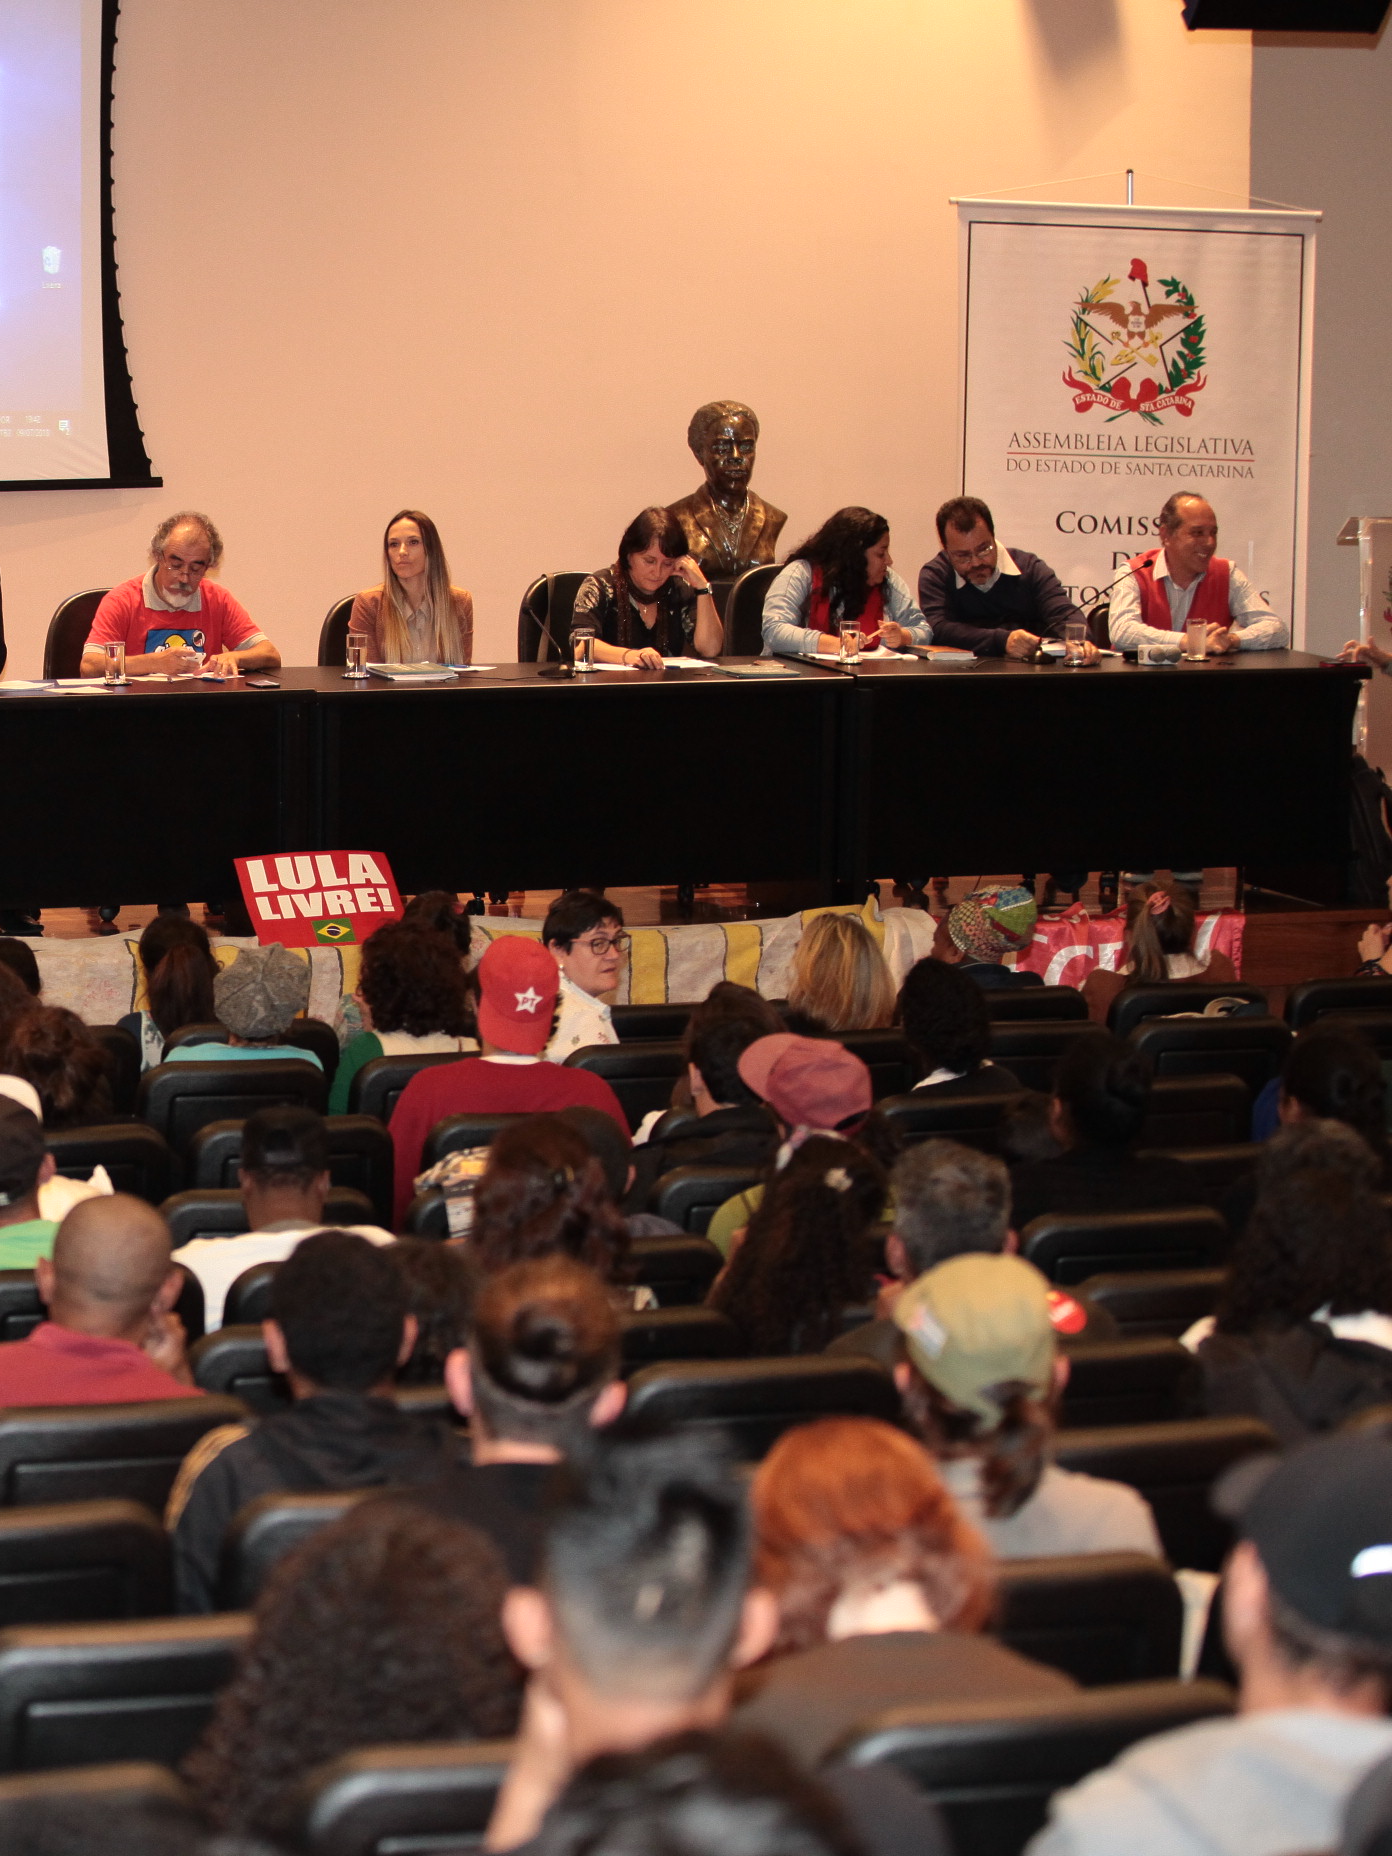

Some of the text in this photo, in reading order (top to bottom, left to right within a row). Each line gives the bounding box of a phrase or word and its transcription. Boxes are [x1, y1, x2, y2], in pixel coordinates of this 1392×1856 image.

[1075, 393, 1109, 404] ESTADO
[1109, 400, 1122, 410] DE
[1008, 431, 1255, 456] ASSEMBLEIA LEGISLATIVA
[1006, 458, 1255, 479] DO ESTADO DE SANTA CATARINA
[1055, 510, 1161, 536] COMISS
[245, 853, 388, 893] LULA
[255, 887, 395, 920] LIVRE!
[521, 996, 536, 1007] PT
